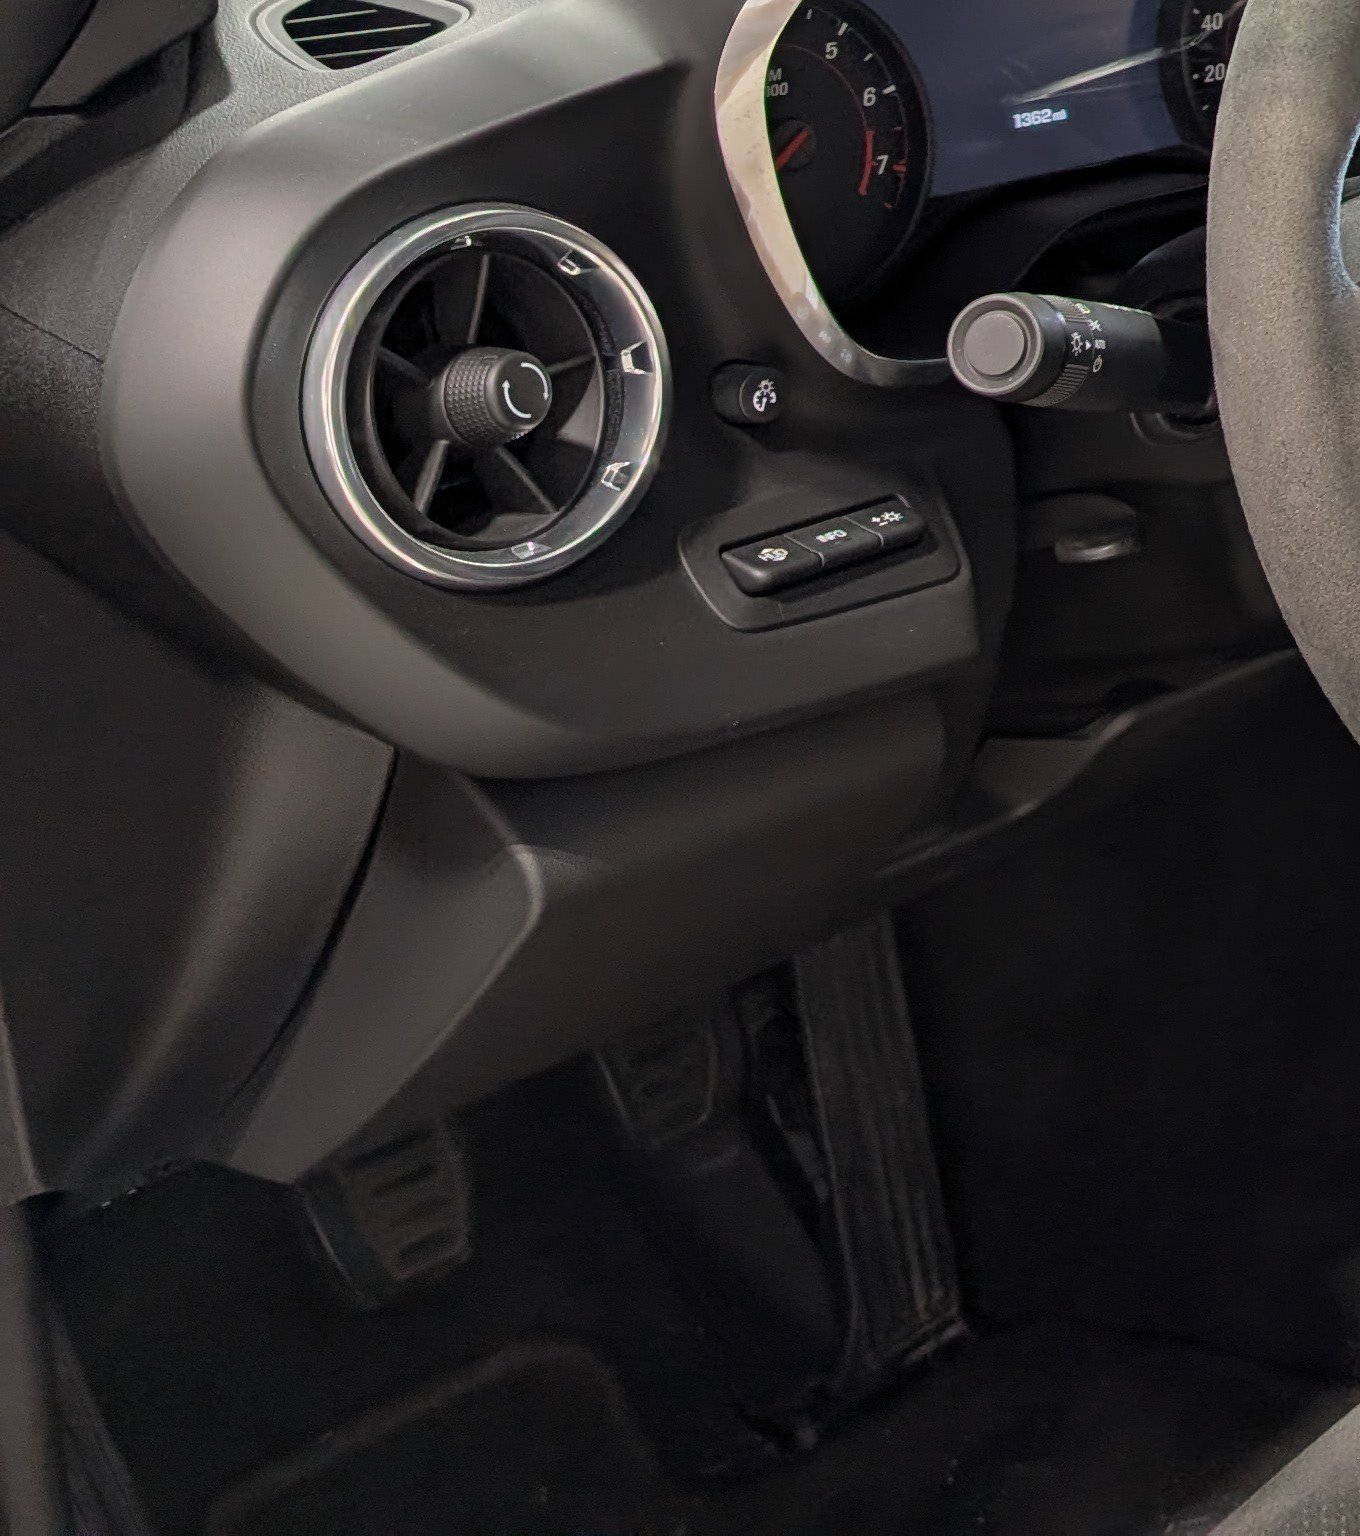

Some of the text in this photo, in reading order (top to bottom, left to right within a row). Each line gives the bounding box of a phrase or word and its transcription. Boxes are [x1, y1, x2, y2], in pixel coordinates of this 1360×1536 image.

[1201, 12, 1223, 31] 40
[825, 41, 838, 60] 5
[1204, 63, 1226, 83] 20
[863, 87, 876, 107] 6
[876, 154, 889, 175] 7
